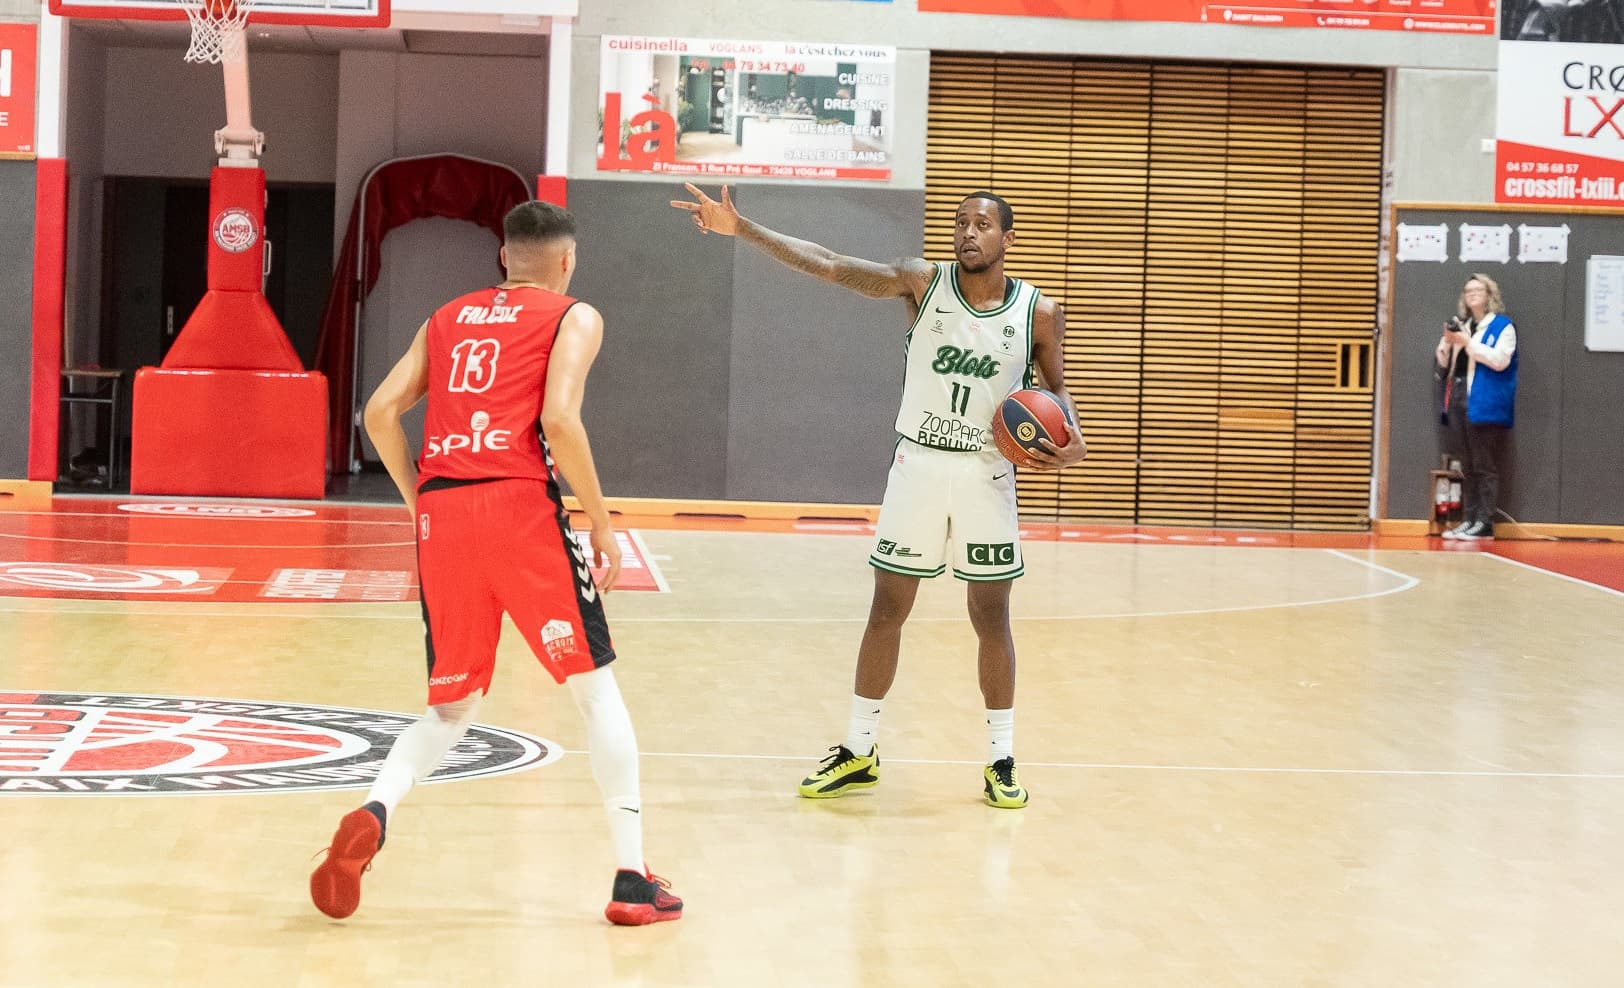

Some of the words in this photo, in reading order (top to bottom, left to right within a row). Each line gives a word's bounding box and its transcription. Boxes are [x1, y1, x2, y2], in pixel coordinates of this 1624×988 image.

[608, 38, 688, 52] cuisinella
[709, 42, 763, 54] VOGLANS
[741, 61, 754, 72] 79
[758, 62, 771, 72] 34
[774, 63, 788, 73] 73
[792, 63, 805, 73] 40
[838, 73, 888, 86] CUISINE
[823, 98, 888, 111] DRESSING
[605, 92, 676, 164] là
[829, 151, 846, 162] DE
[848, 151, 886, 163] BAINS
[707, 164, 724, 174] Rue
[794, 167, 837, 177] VOGLANS
[1506, 162, 1520, 172] 04
[1521, 162, 1535, 172] 57
[1566, 164, 1580, 173] 57
[448, 338, 500, 393] 13
[932, 345, 1000, 379] Blois
[951, 381, 971, 417] 11
[971, 545, 1012, 563] CIC
